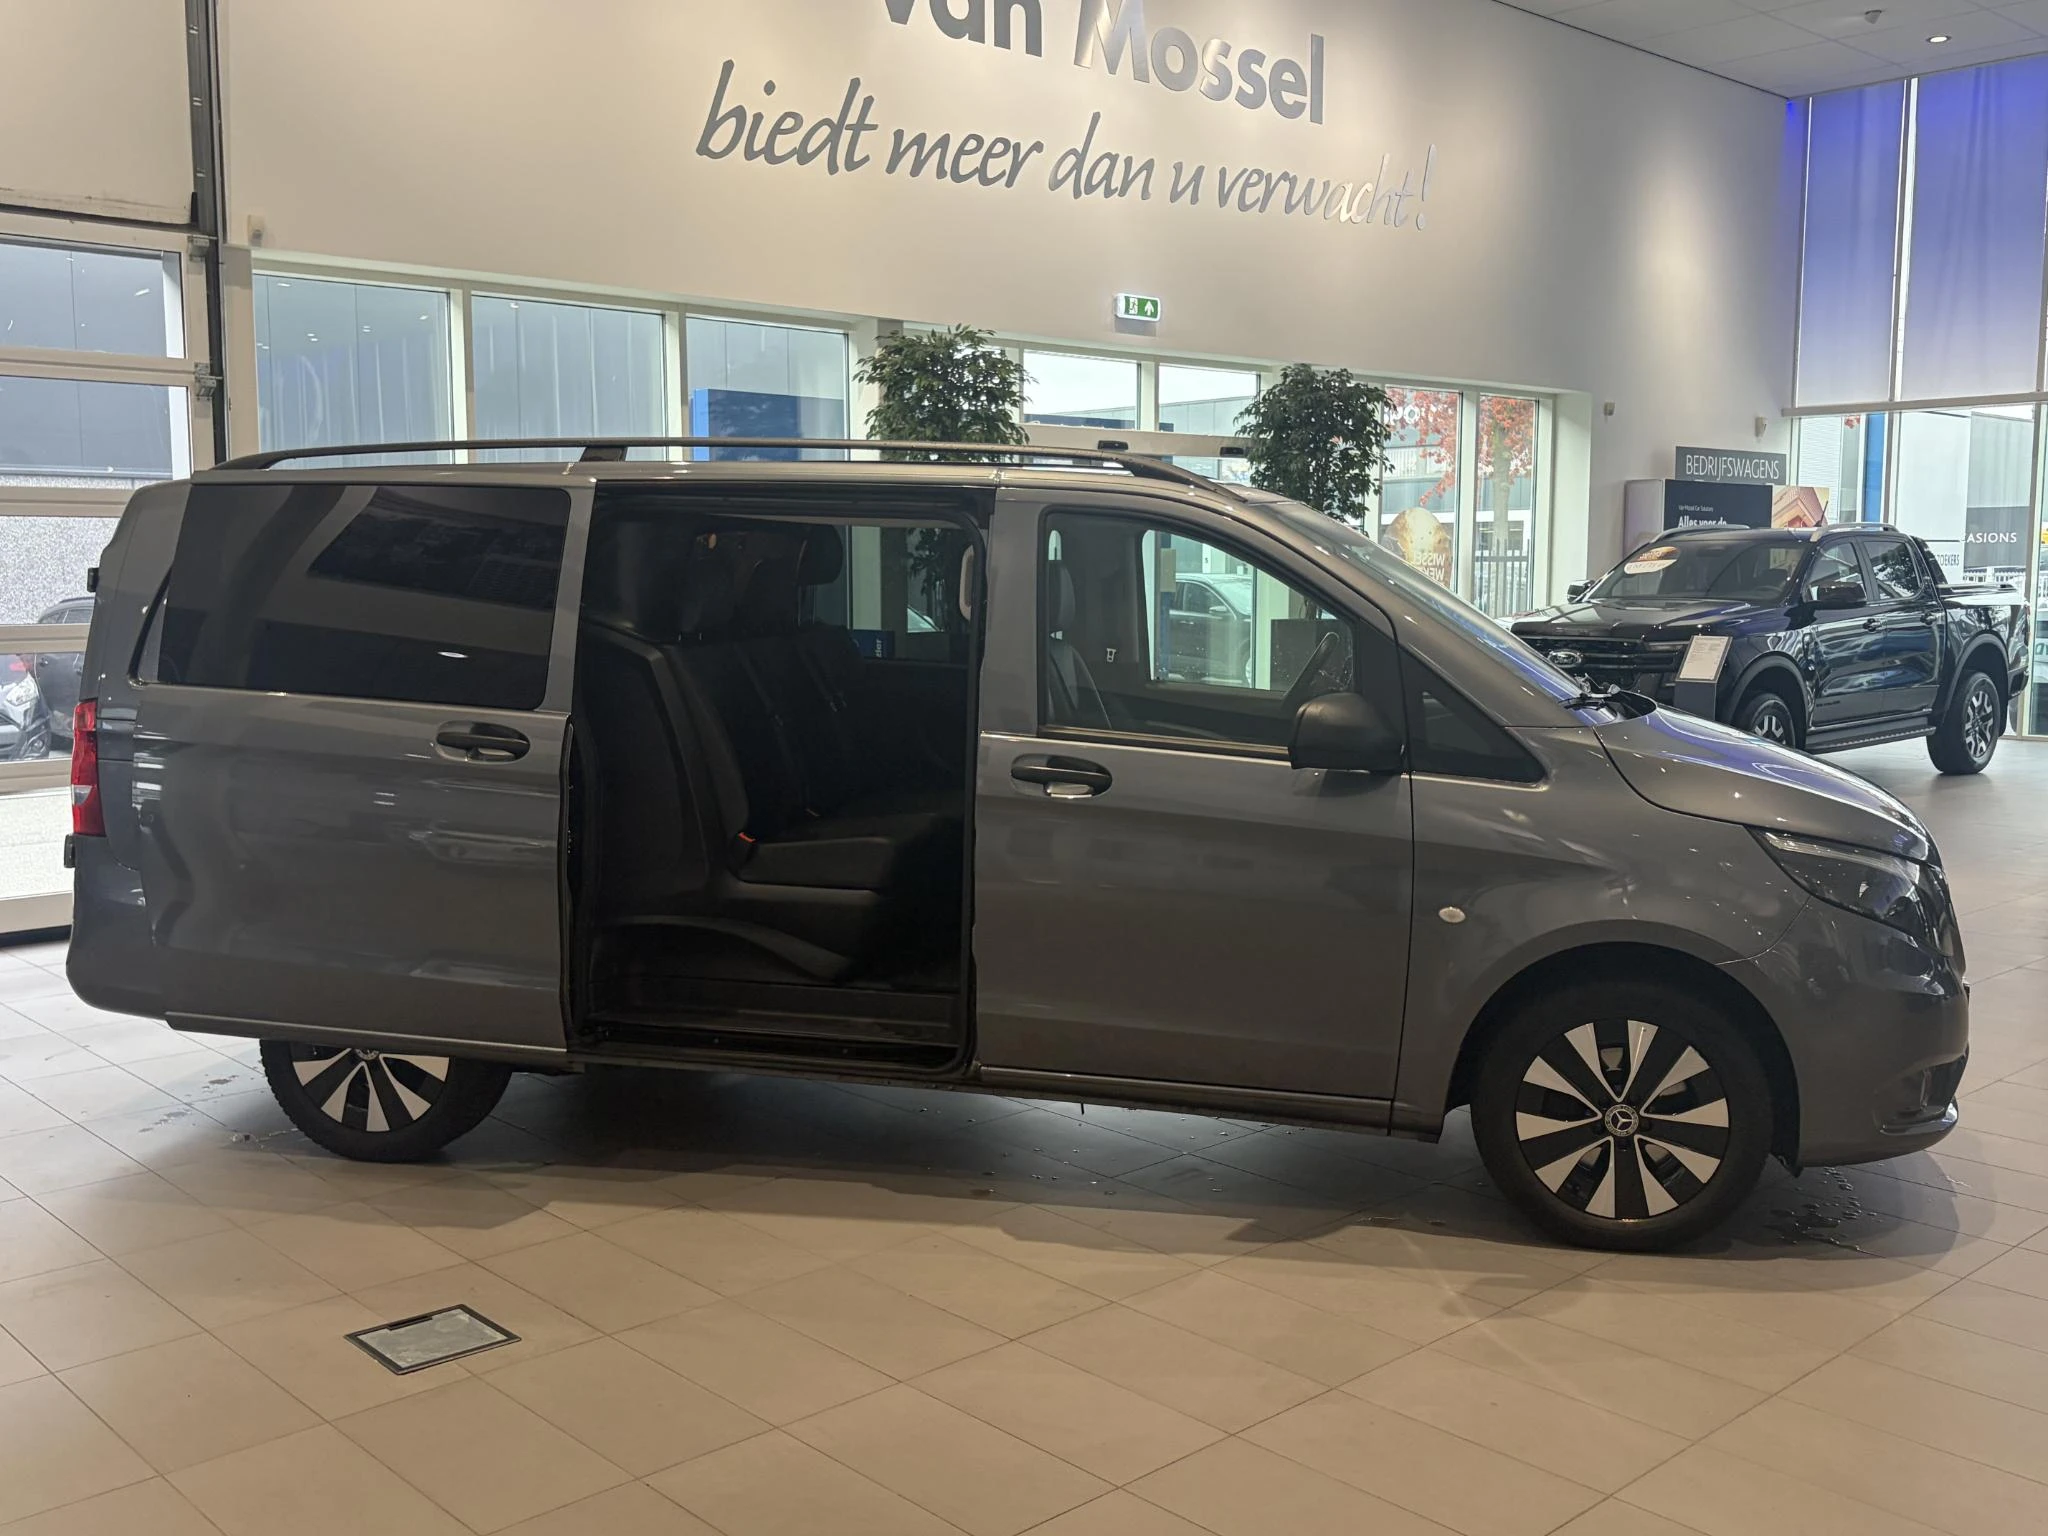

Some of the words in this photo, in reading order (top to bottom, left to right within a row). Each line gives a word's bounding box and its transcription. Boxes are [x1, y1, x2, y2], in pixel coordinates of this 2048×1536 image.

[885, 0, 1043, 58] an
[1073, 0, 1325, 125] Mossel
[696, 59, 879, 176] biedt
[885, 128, 1045, 189] meer
[1048, 111, 1156, 201] dan
[1169, 161, 1206, 206] u
[1217, 144, 1438, 231] verwacht!
[1686, 454, 1780, 480] BEDRIJFSWAGENS
[1966, 532, 2017, 543] ASIONS
